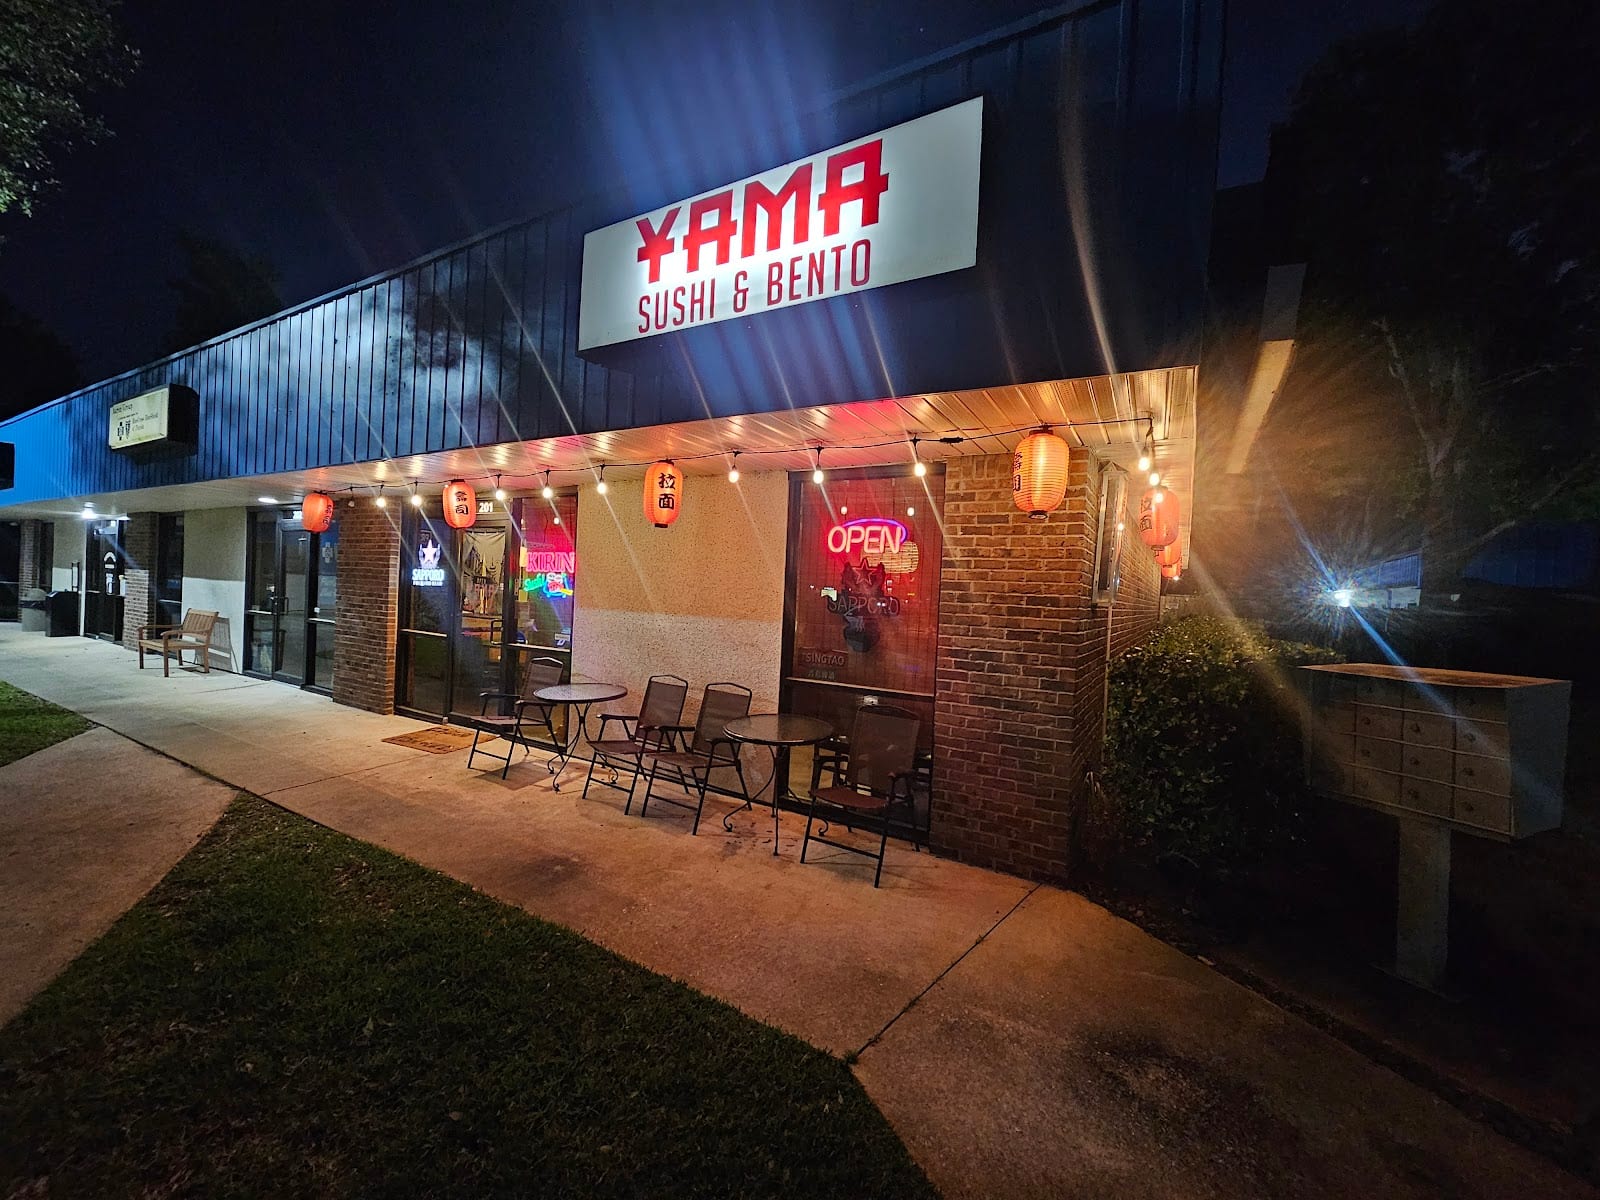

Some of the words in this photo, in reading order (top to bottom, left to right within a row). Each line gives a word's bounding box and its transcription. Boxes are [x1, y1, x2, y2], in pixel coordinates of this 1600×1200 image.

[636, 139, 889, 284] YAMA
[638, 279, 714, 333] SUSHI
[733, 271, 749, 312] &
[768, 240, 871, 306] BENTO
[479, 502, 493, 512] 201
[828, 526, 900, 553] OPEN
[526, 551, 575, 573] KIRIN
[412, 568, 444, 581] SAPPORO
[828, 596, 899, 615] SAPPORO
